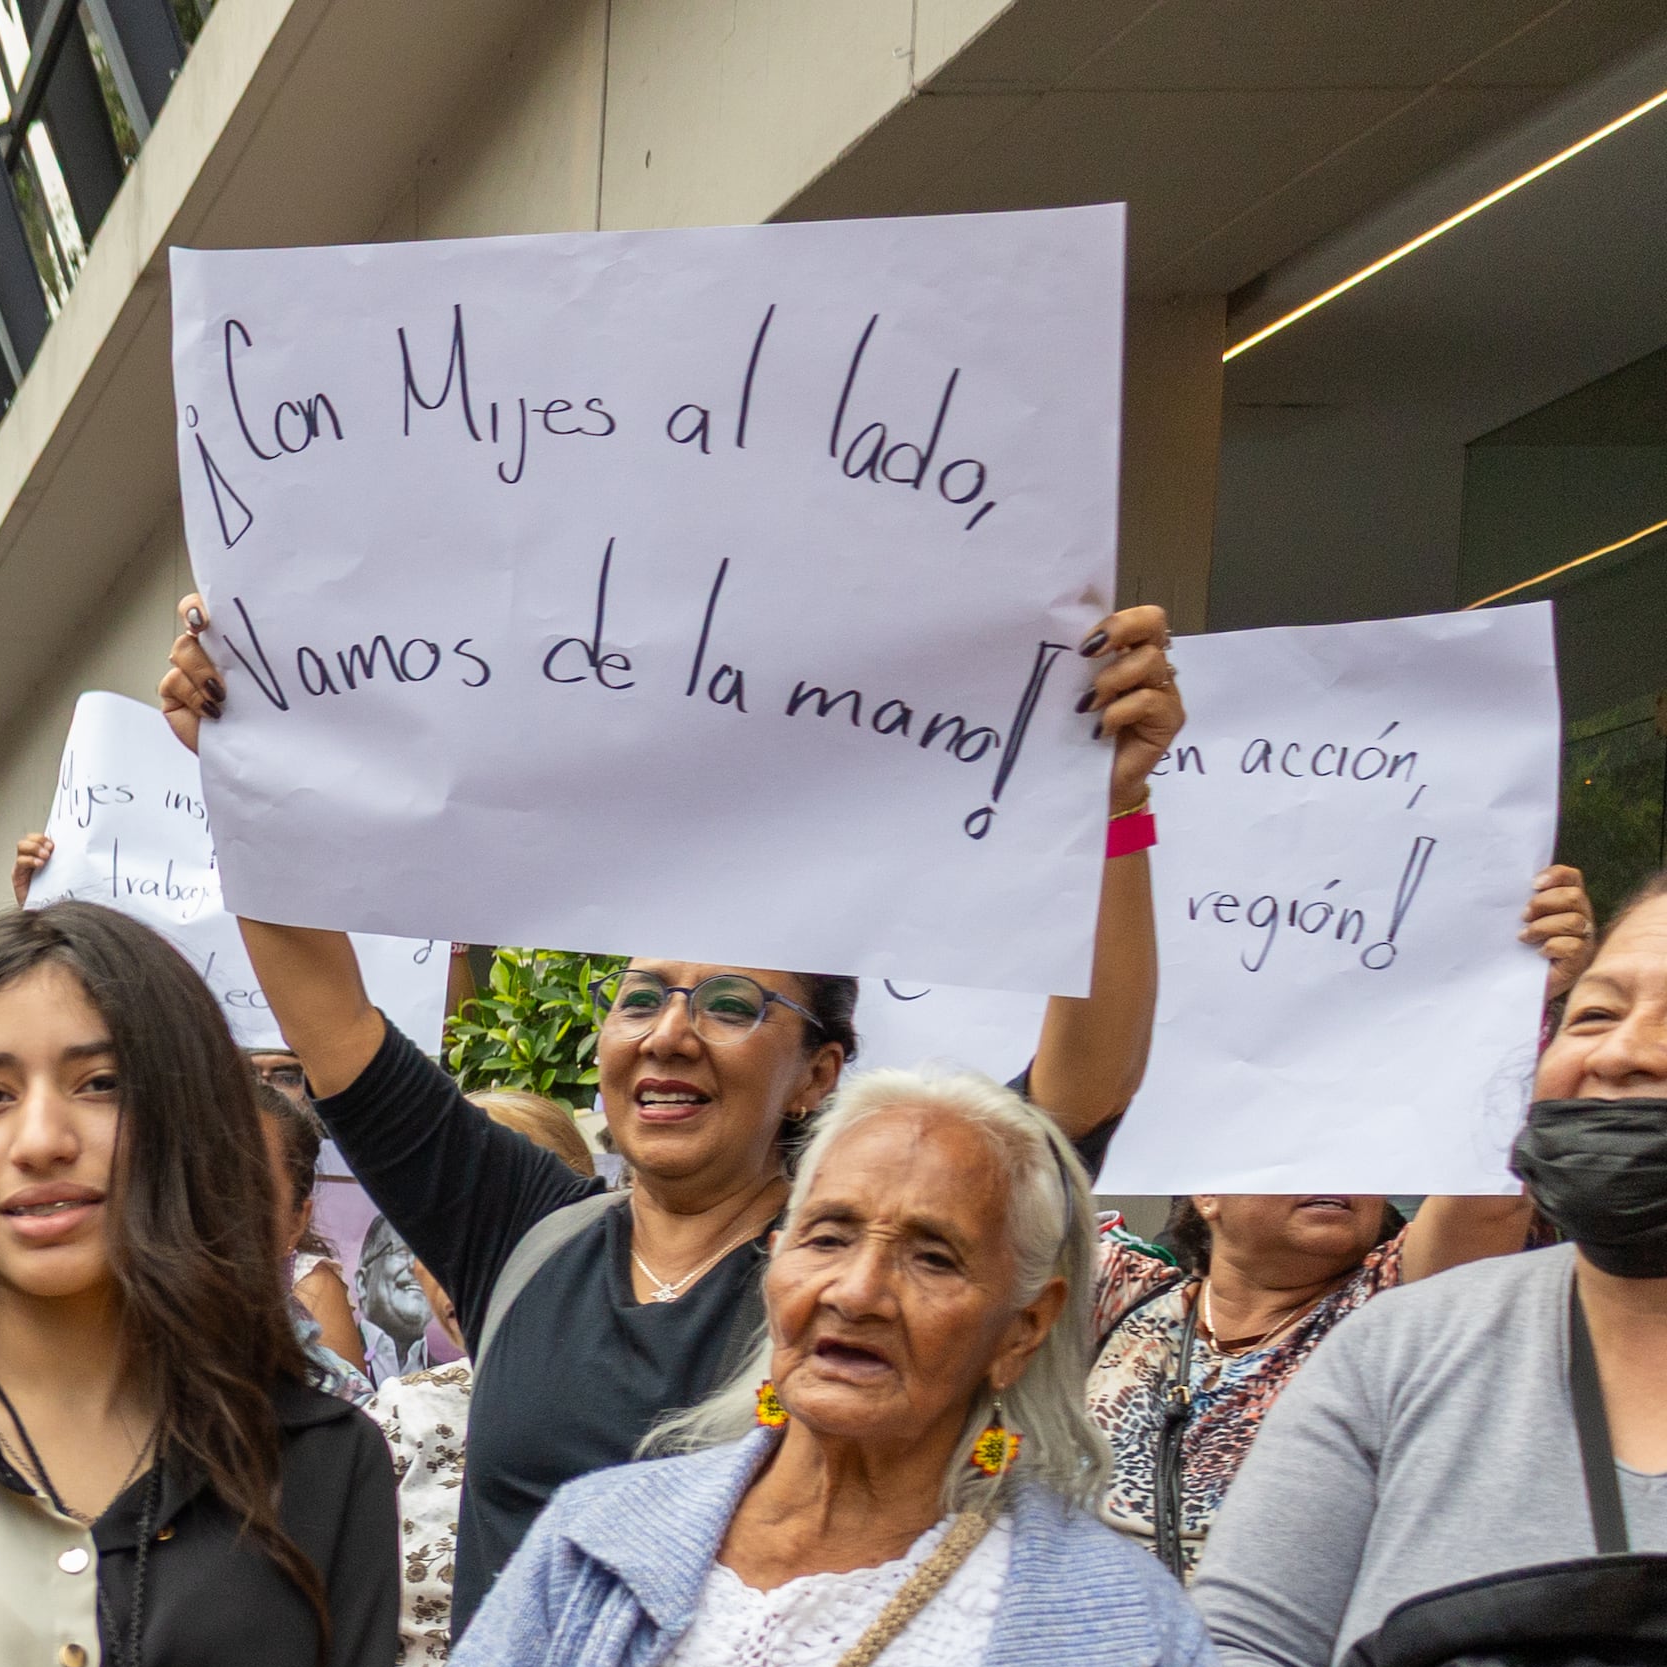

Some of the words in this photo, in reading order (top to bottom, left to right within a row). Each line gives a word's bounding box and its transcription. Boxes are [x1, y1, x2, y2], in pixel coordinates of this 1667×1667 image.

[396, 303, 617, 485] Mijes
[665, 303, 777, 455] al
[828, 313, 998, 532] lado,
[222, 596, 492, 713] Vamos
[542, 536, 636, 690] de
[685, 556, 748, 714] la
[784, 640, 1073, 841] mano!
[1240, 720, 1428, 810] acción,
[1188, 835, 1438, 972] región!
